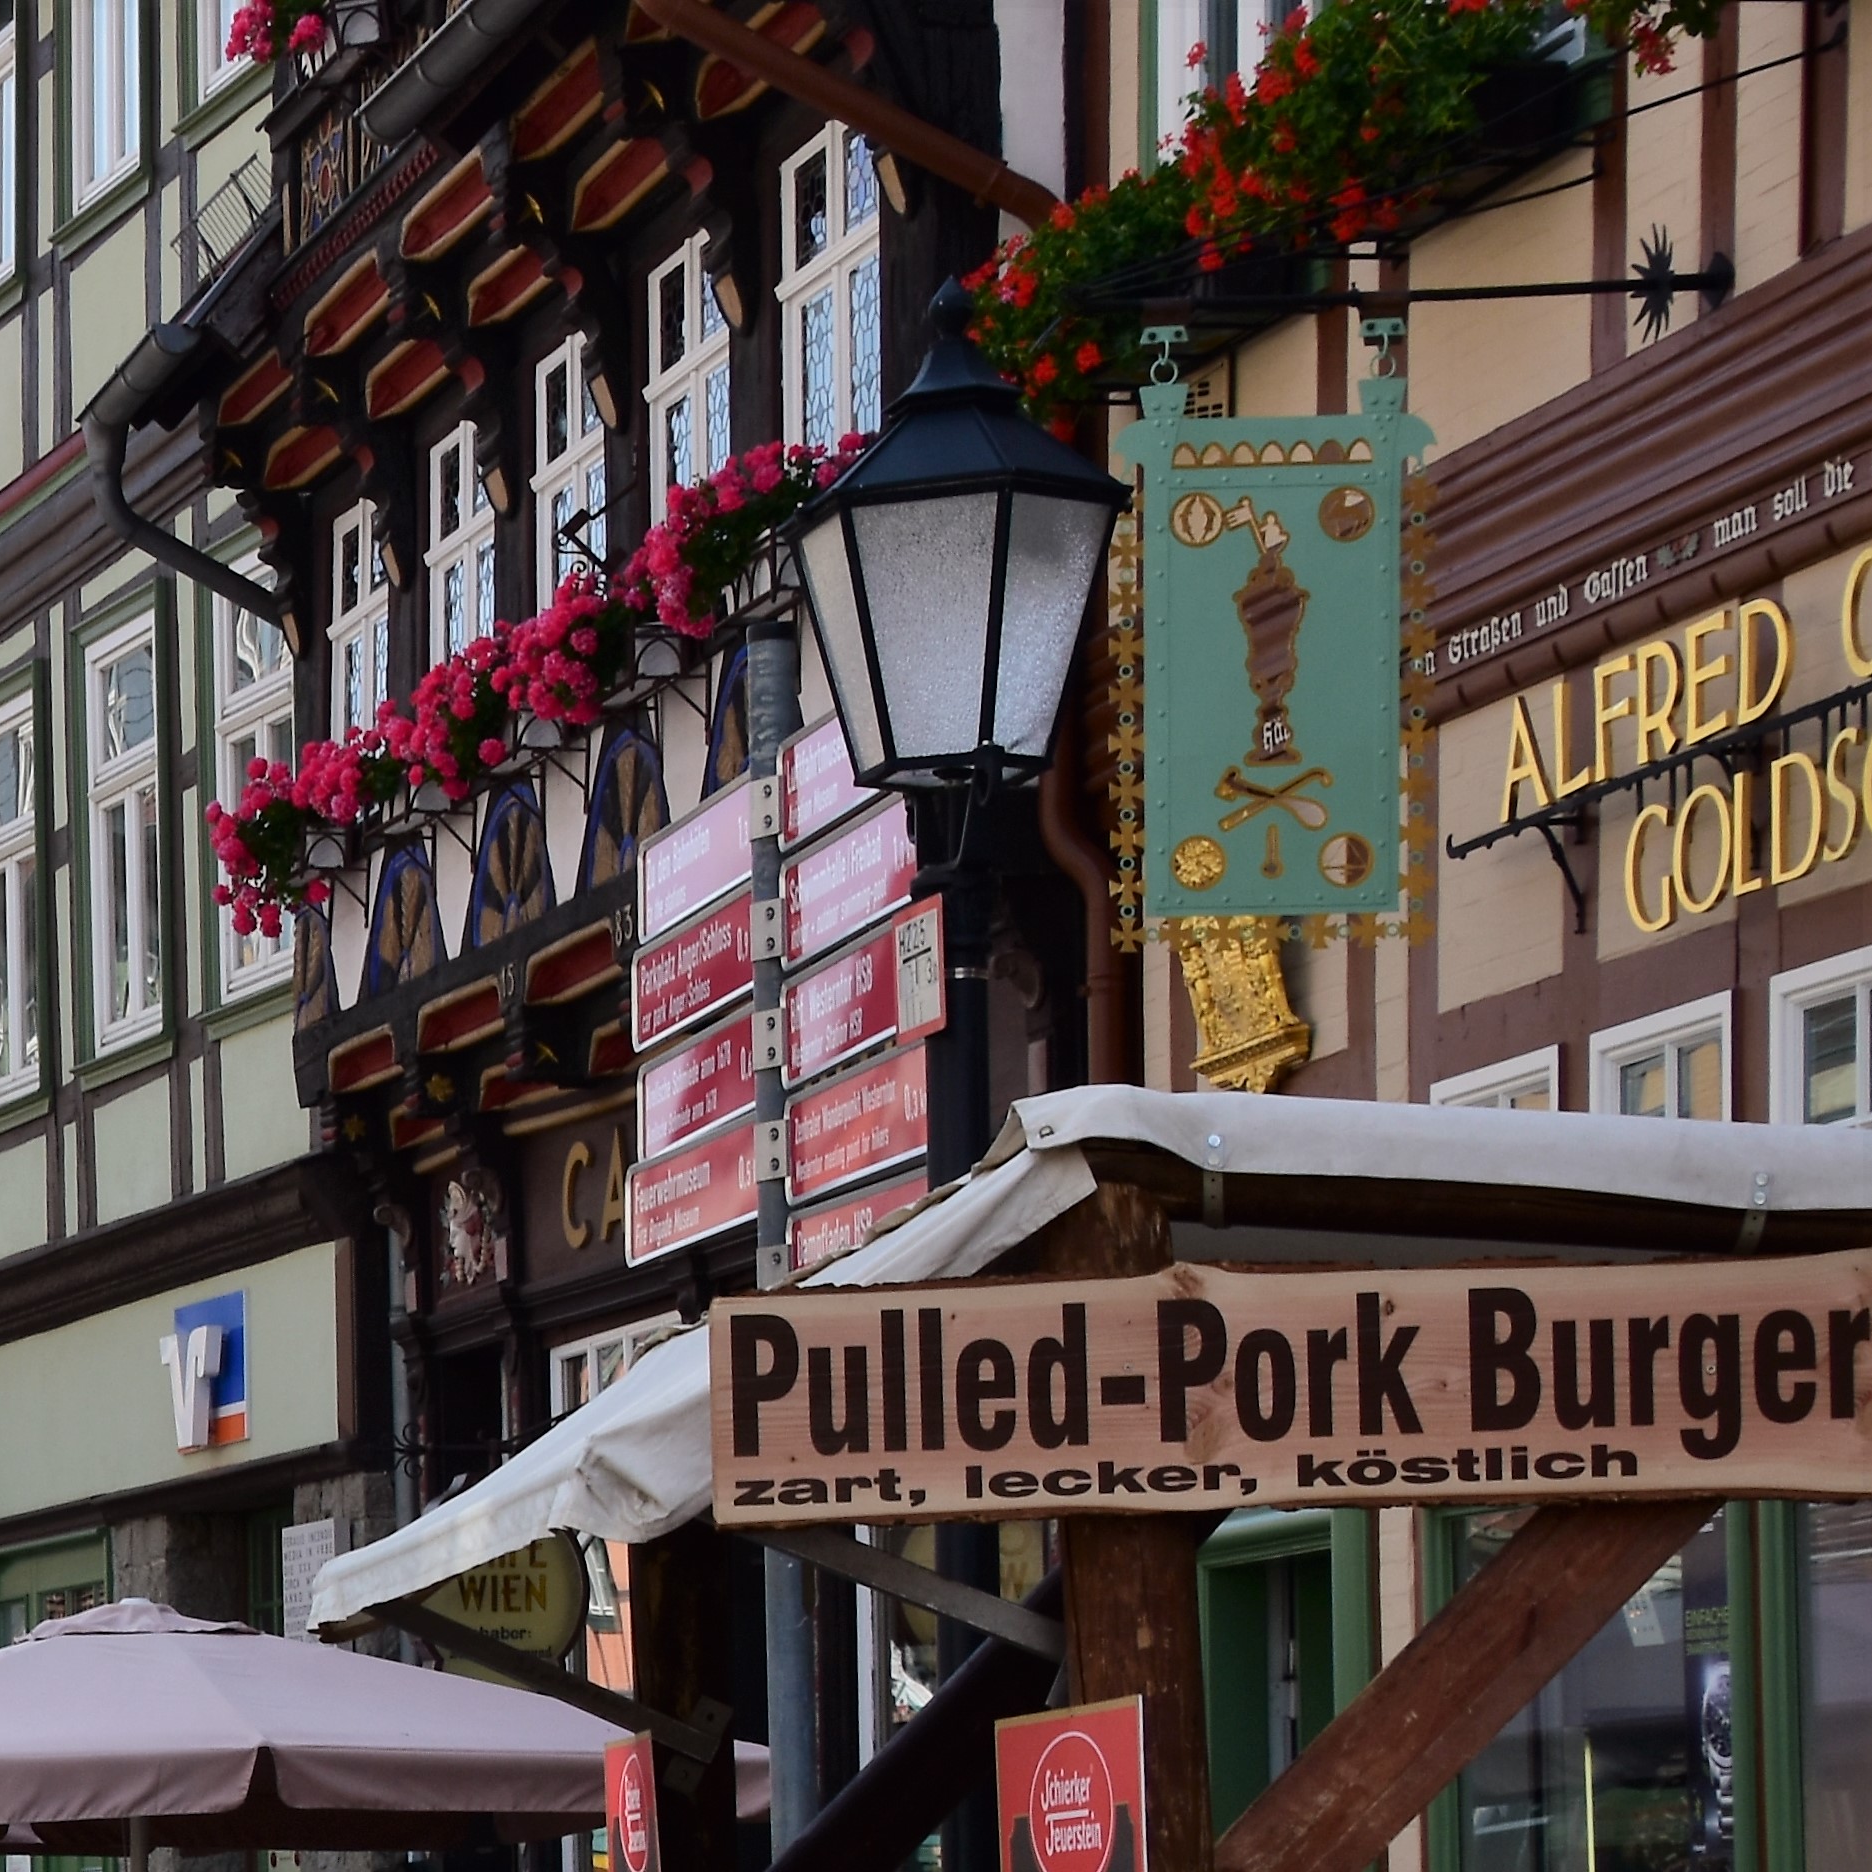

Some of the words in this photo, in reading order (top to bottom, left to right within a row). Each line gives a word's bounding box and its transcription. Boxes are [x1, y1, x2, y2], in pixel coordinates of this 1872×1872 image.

[1536, 584, 1569, 628] und
[1714, 506, 1758, 547] man
[1774, 476, 1808, 521] soll
[1823, 456, 1854, 498] die
[1501, 598, 1790, 824] ALFRED
[1624, 726, 1872, 932] GOLDS
[640, 948, 677, 998] Parkplatz
[855, 953, 873, 998] HSB
[849, 1007, 863, 1039] HSB
[635, 1161, 710, 1214] Feuerwehrmuseum
[635, 1223, 648, 1249] Fire
[649, 1212, 673, 1247] Brigade
[673, 1206, 700, 1234] Museum
[797, 1217, 851, 1267] Dampfladen
[730, 1291, 1423, 1458] Pulled-Pork
[1467, 1285, 1872, 1461] Burger
[735, 1467, 928, 1510] zart,
[966, 1457, 1257, 1497] lecker,
[1298, 1442, 1641, 1489] köstlich
[457, 1574, 547, 1613] WIEN
[1040, 1768, 1093, 1811] Schierker
[1045, 1811, 1103, 1857] Feuerstein
